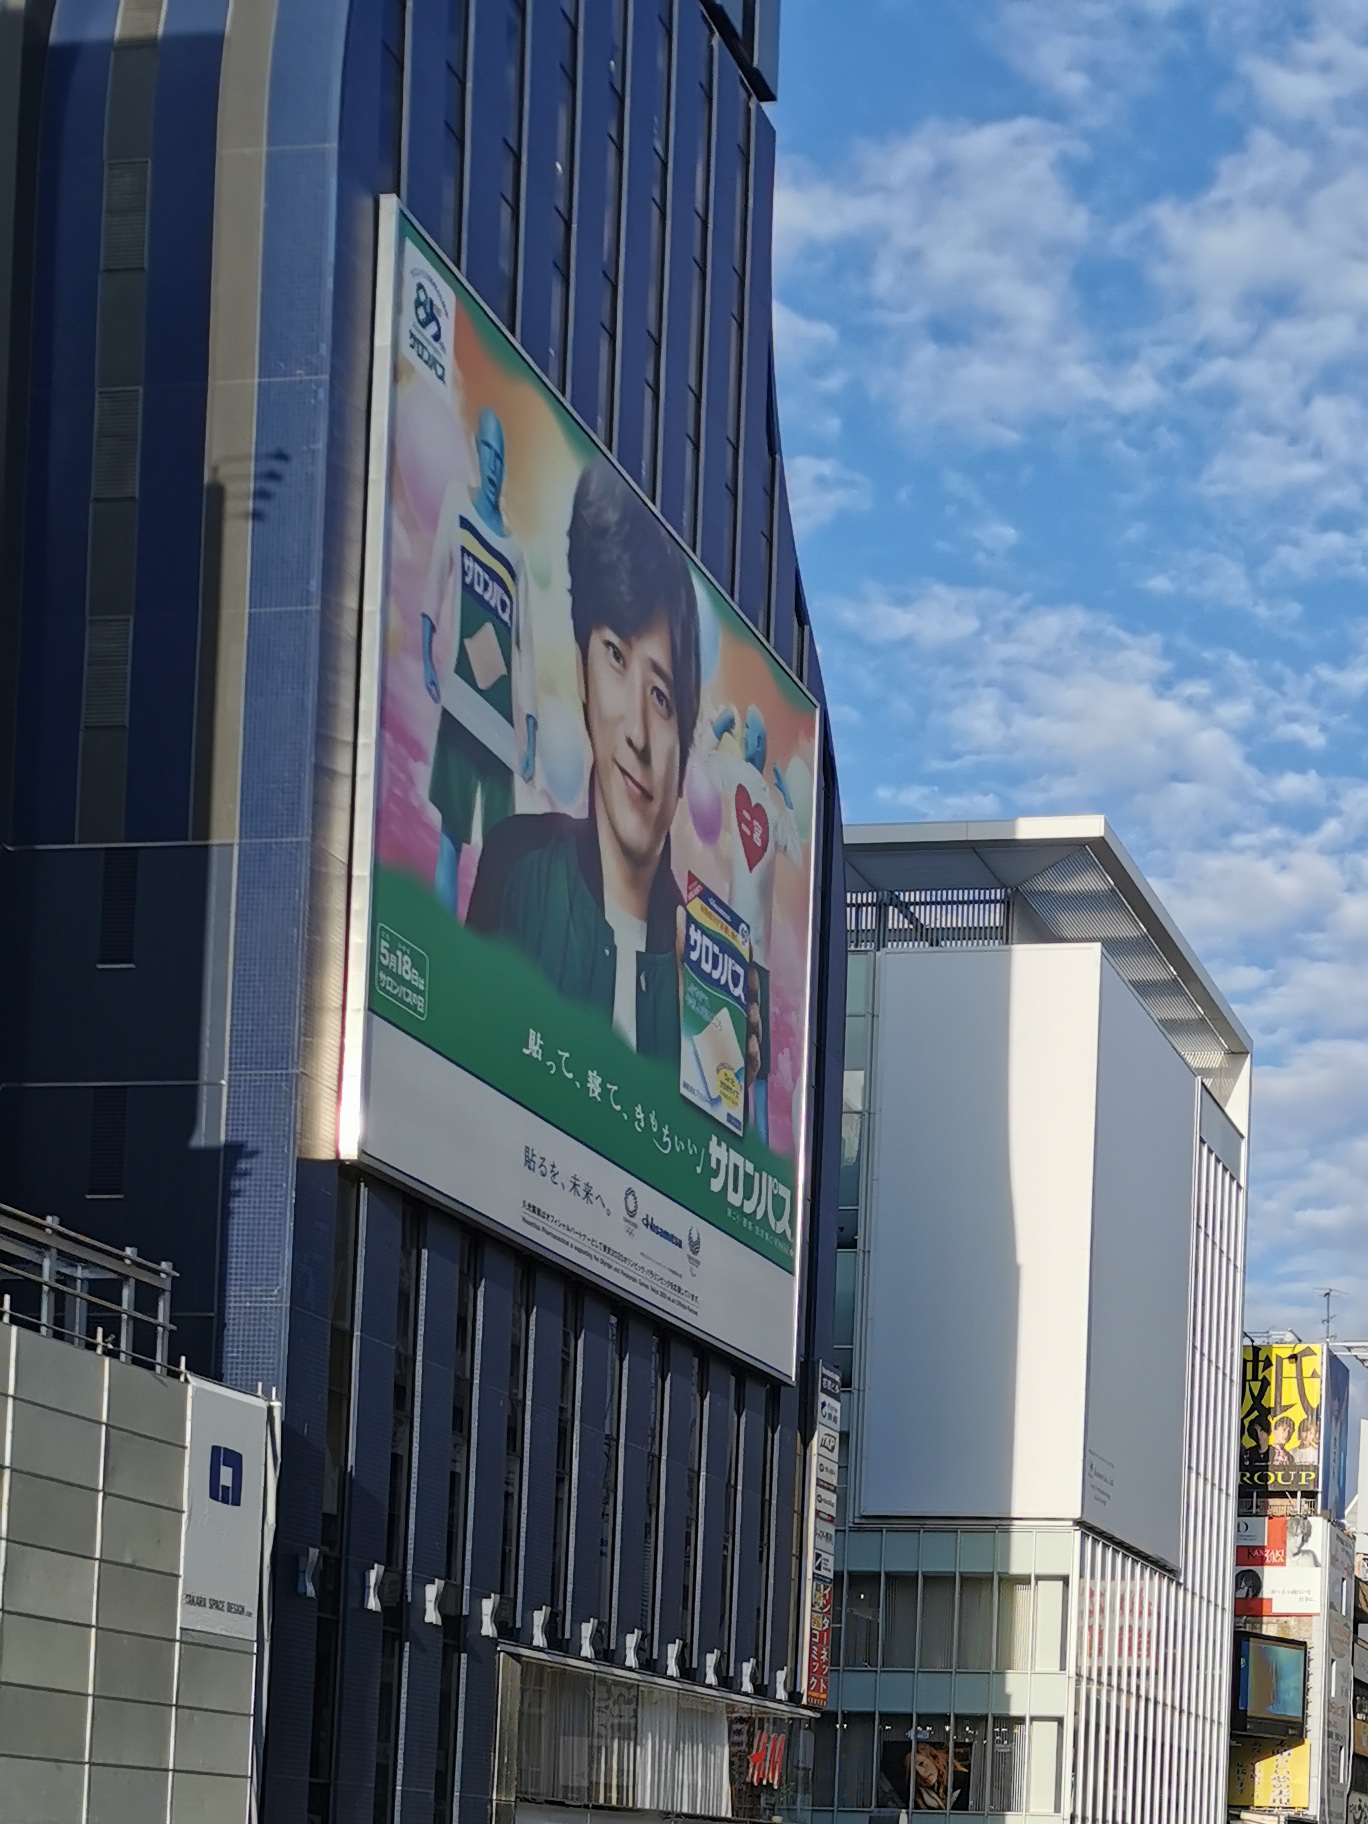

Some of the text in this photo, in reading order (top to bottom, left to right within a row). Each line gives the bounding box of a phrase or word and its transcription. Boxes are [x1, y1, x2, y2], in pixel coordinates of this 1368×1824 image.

[688, 923, 747, 1004] サロンパス
[708, 1134, 793, 1241] サロンパス
